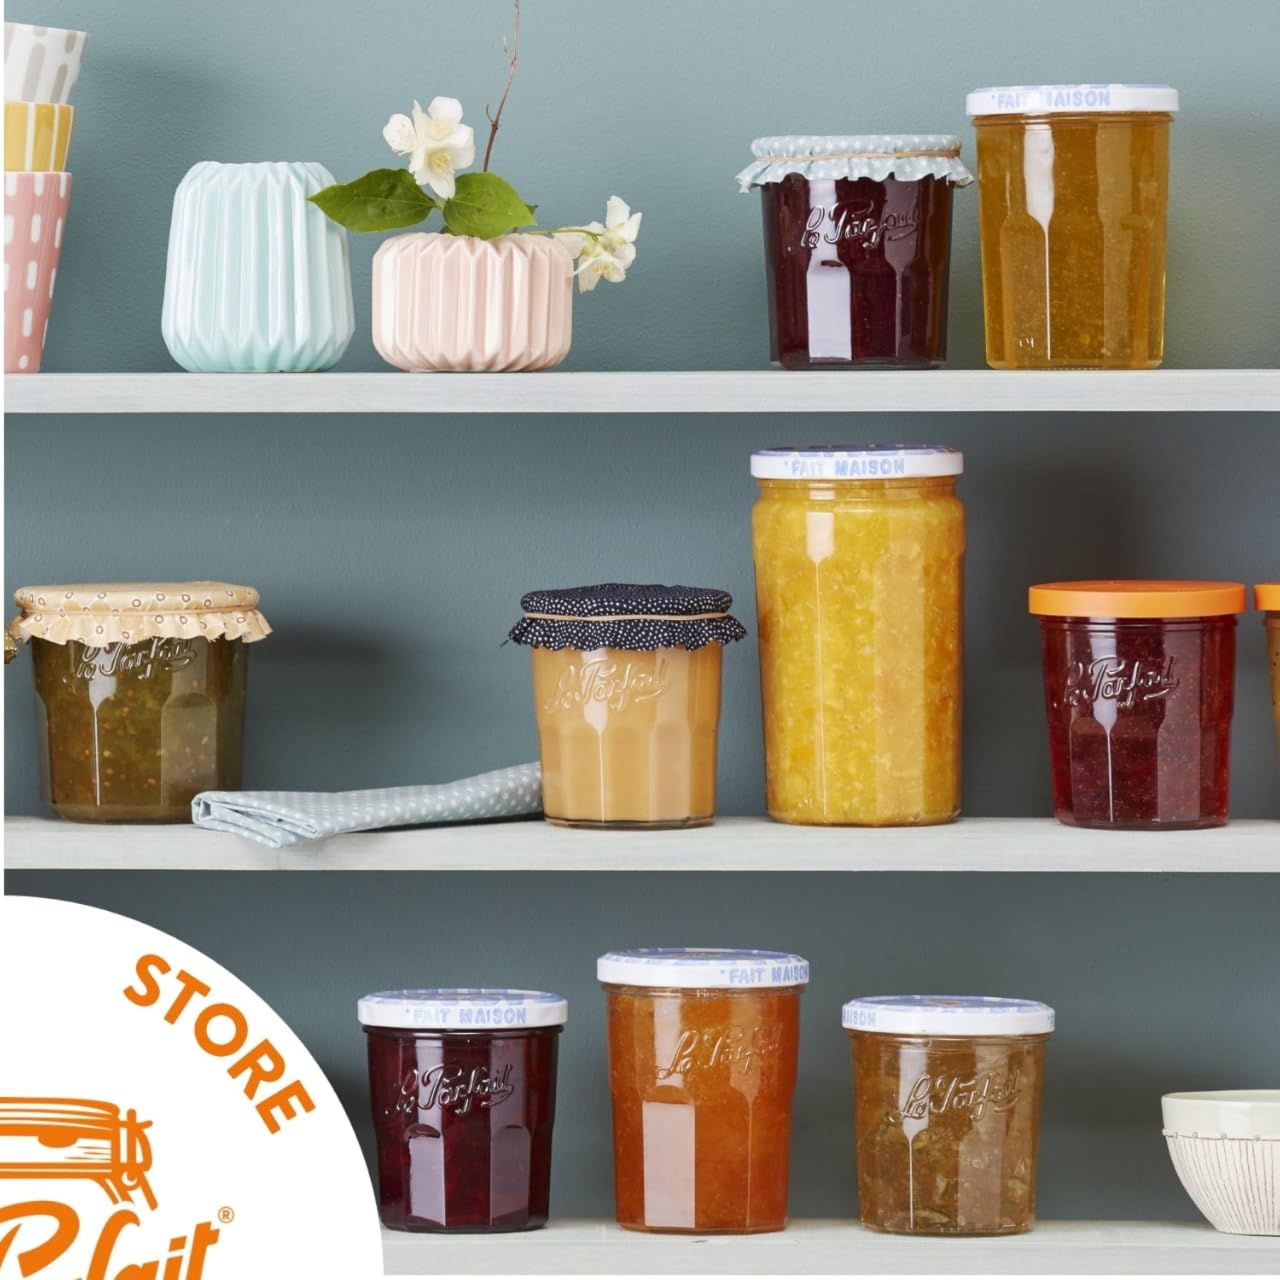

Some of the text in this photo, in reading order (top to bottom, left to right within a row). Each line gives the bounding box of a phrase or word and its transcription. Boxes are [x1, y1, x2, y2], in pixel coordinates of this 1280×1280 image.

[997, 92, 1025, 109] FAI
[835, 458, 905, 476] MAISON
[459, 1007, 527, 1024] MAISON
